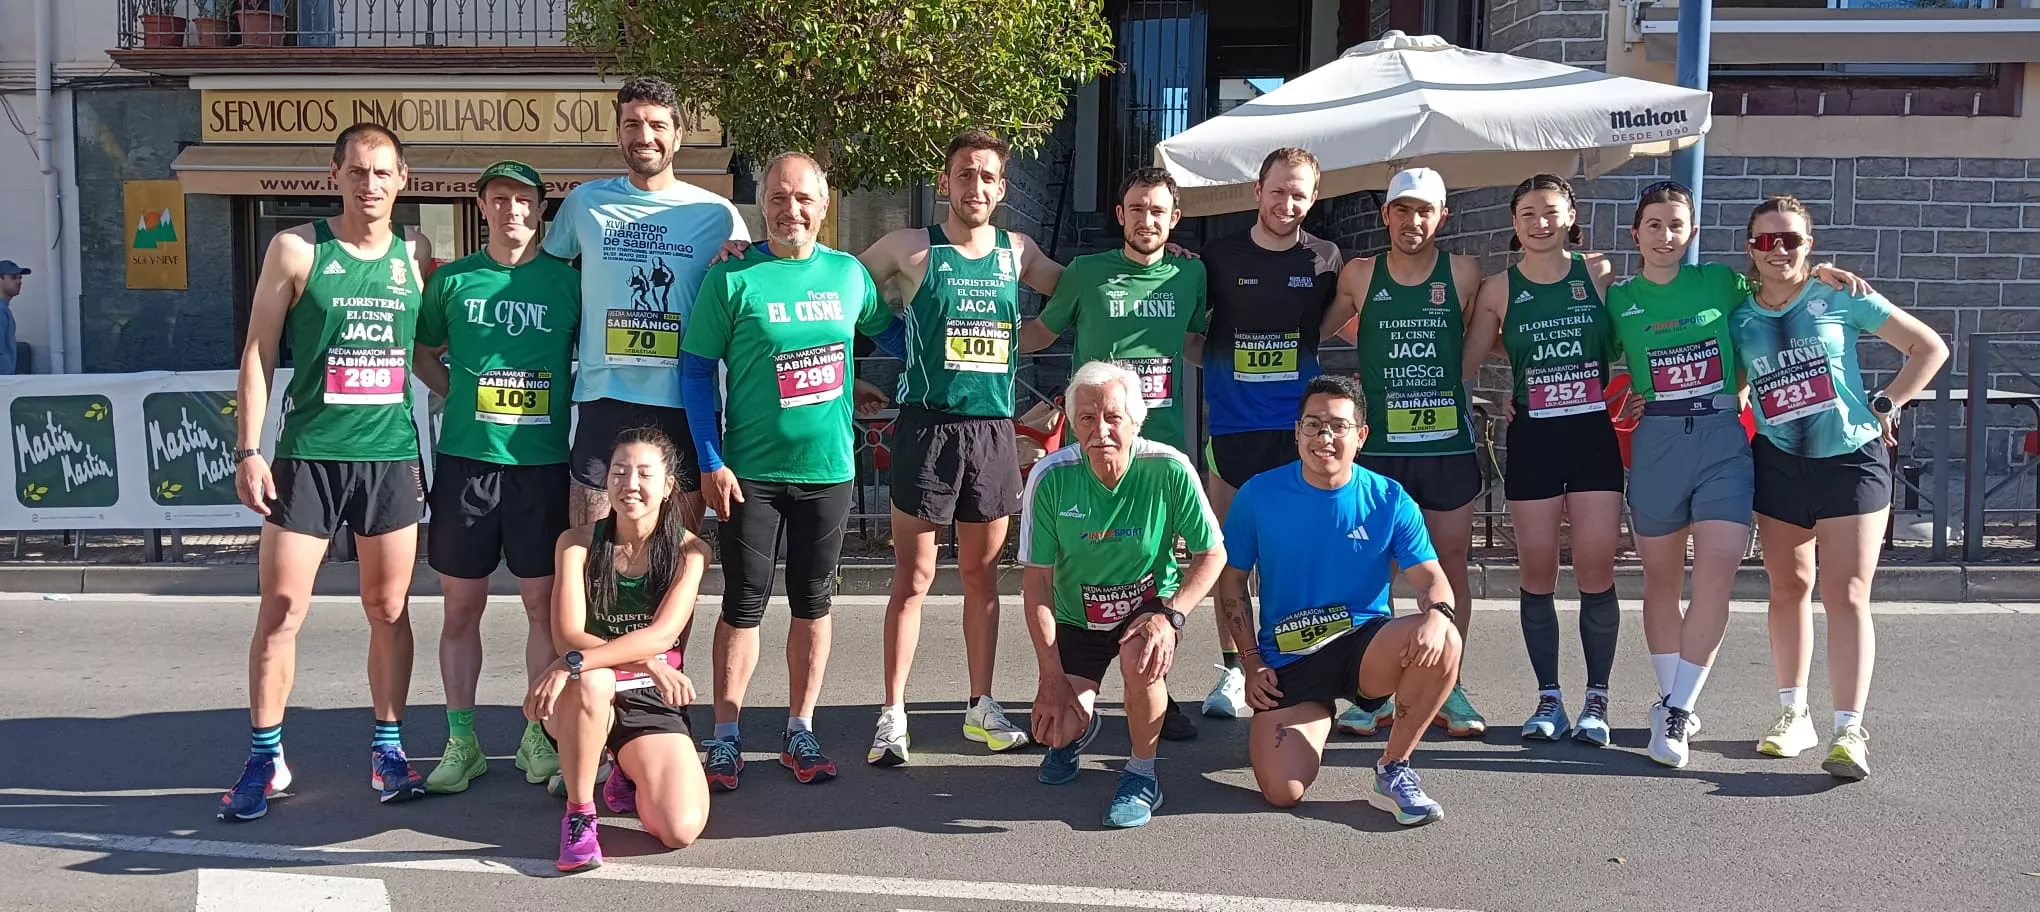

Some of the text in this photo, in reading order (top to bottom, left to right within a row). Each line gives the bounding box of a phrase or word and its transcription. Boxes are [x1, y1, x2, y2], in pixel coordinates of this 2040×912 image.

[209, 98, 338, 132] SERVICIOS
[352, 98, 540, 132] INMOBILIARIOS
[554, 98, 608, 133] SOL
[1610, 107, 1688, 130] Mahou
[1612, 126, 1689, 143] DESDE 1890
[807, 289, 840, 300] flores
[969, 289, 998, 297] CISNE
[1146, 290, 1175, 300] flores
[332, 296, 406, 311] FLORISTERÍA
[767, 300, 844, 323] EL CISNE
[956, 298, 997, 313] JACA
[1109, 299, 1176, 318] EL CISNE
[346, 310, 394, 322] EL CISNE
[464, 298, 552, 337] EL CISNE
[626, 311, 659, 319] MARATON
[946, 319, 966, 327] MEDIA
[966, 320, 994, 328] MARATON
[1379, 316, 1447, 329] FLORISTERÍA
[1519, 313, 1594, 333] FLORISTERÍA
[607, 317, 680, 331] SABIÑÁNIGO
[341, 323, 394, 343] JACA
[626, 331, 656, 349] 70
[946, 327, 1010, 339] SABIÑÁNIGO
[1252, 333, 1281, 341] MARATON
[1390, 330, 1436, 340] EL CISNE
[1532, 327, 1582, 343] EL CISNE
[328, 347, 351, 356] MEDIA
[352, 348, 386, 357] MARATON
[963, 338, 995, 357] 101
[1234, 340, 1298, 350] SABIÑÁNIGO
[1388, 342, 1437, 359] JACA
[1532, 340, 1583, 361] JACA
[1648, 349, 1668, 357] MEDIA
[1668, 343, 1701, 355] MARATON
[327, 355, 405, 368] SABIÑÁNIGO
[774, 354, 796, 362] MEDIA
[796, 346, 826, 359] MARATON
[776, 351, 845, 372] SABIÑÁNIGO
[1132, 358, 1159, 366] MARATON
[1247, 350, 1283, 367] 102
[1650, 347, 1719, 367] SABIÑÁNIGO
[502, 370, 535, 379] MARATON
[1134, 364, 1172, 375] ÑÁNIGO
[1527, 366, 1547, 376] MEDIA
[1547, 364, 1579, 374] MARATON
[1667, 360, 1708, 385] 217
[1752, 355, 1776, 377] EL
[478, 376, 550, 389] SABIÑÁNIGO
[793, 364, 836, 390] 299
[1141, 374, 1164, 393] 65
[1527, 368, 1600, 386] SABIÑÁNIGO
[1680, 379, 1701, 388] MARTA
[1755, 375, 1772, 386] MEDIA
[1771, 365, 1803, 381] MARATON
[1757, 365, 1827, 395] SABIÑÁNIGO
[495, 389, 537, 408] 103
[1386, 391, 1406, 400] MEDIA
[1406, 391, 1437, 399] MARATON
[1543, 381, 1587, 403] 252
[1772, 380, 1816, 408] 231
[1387, 397, 1455, 409] SABIÑÁNIGO
[1408, 409, 1437, 427] 78
[196, 440, 237, 490] Mart
[1082, 583, 1137, 594] MEDIA MARATON
[1083, 579, 1155, 602] SABIÑÁNIGO
[1100, 595, 1143, 618] 292
[1293, 608, 1325, 620] MARATON
[1274, 611, 1349, 635] SABIÑÁNIGO
